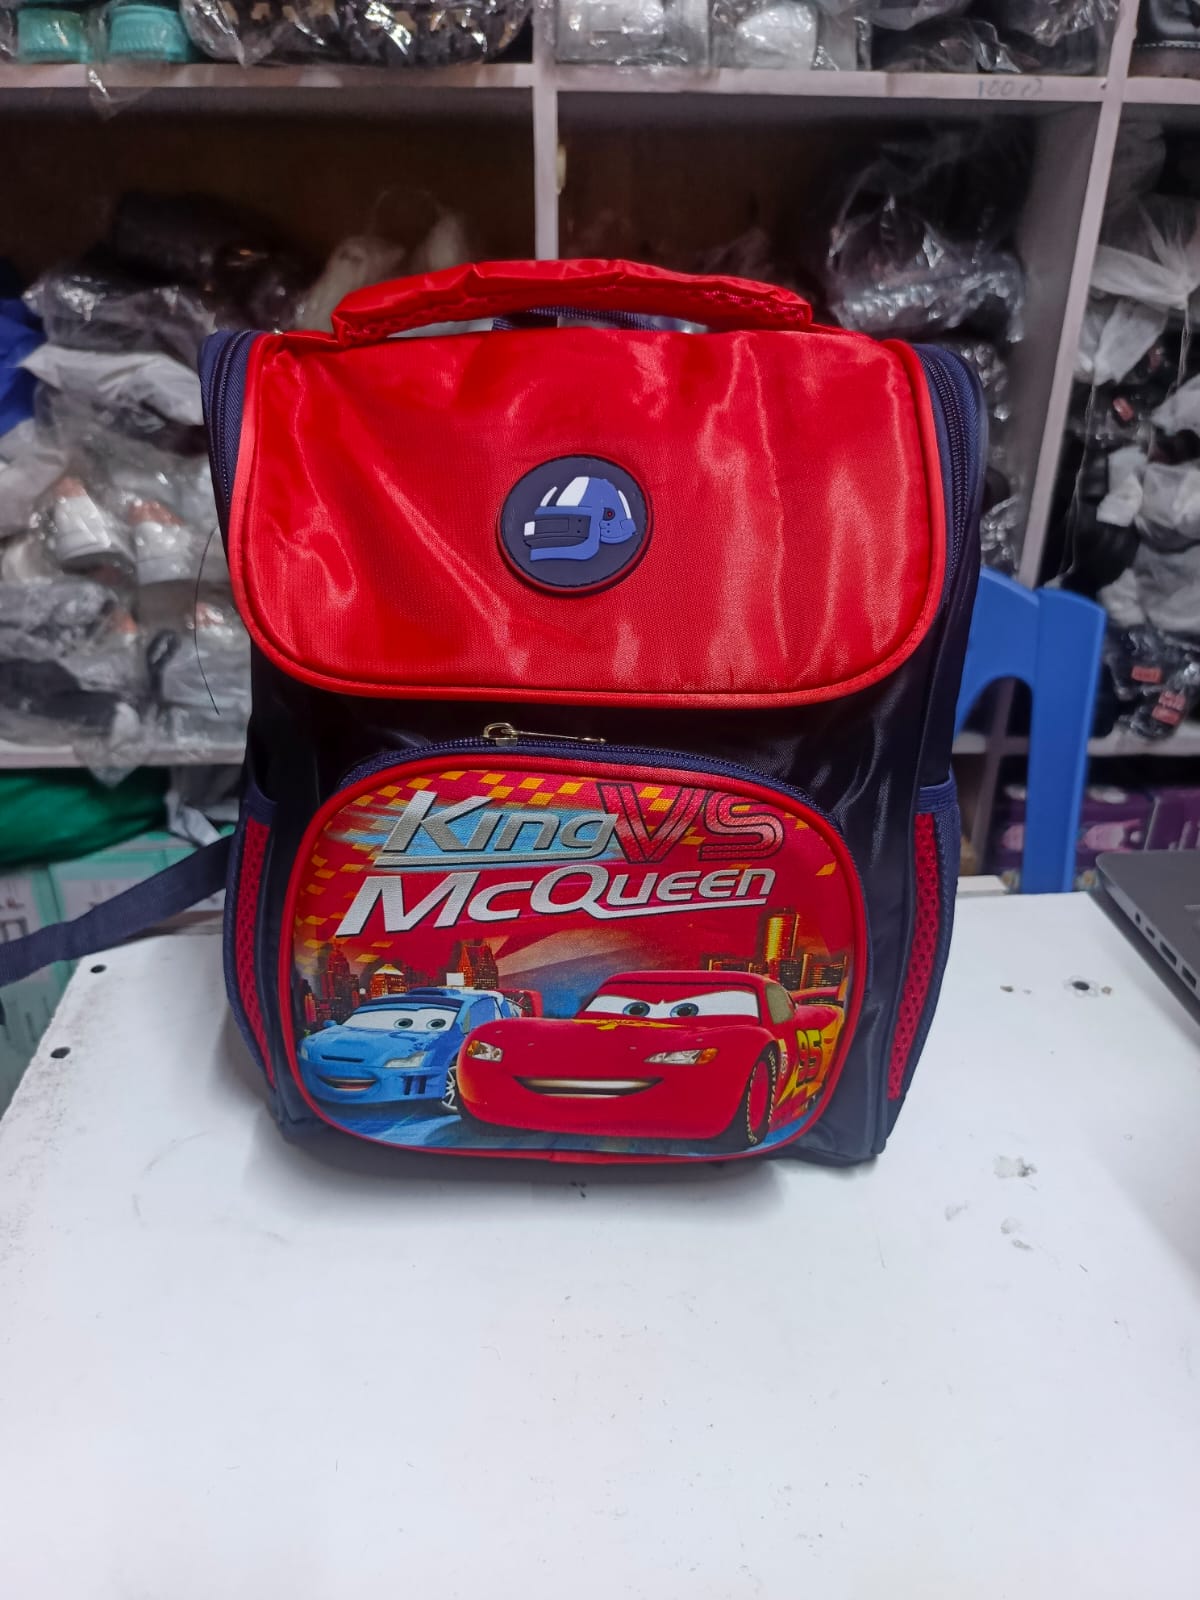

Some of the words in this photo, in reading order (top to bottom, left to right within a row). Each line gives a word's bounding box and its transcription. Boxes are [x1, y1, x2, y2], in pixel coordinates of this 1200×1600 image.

[373, 790, 619, 868] King
[597, 783, 785, 864] VS
[796, 1029, 823, 1088] 95
